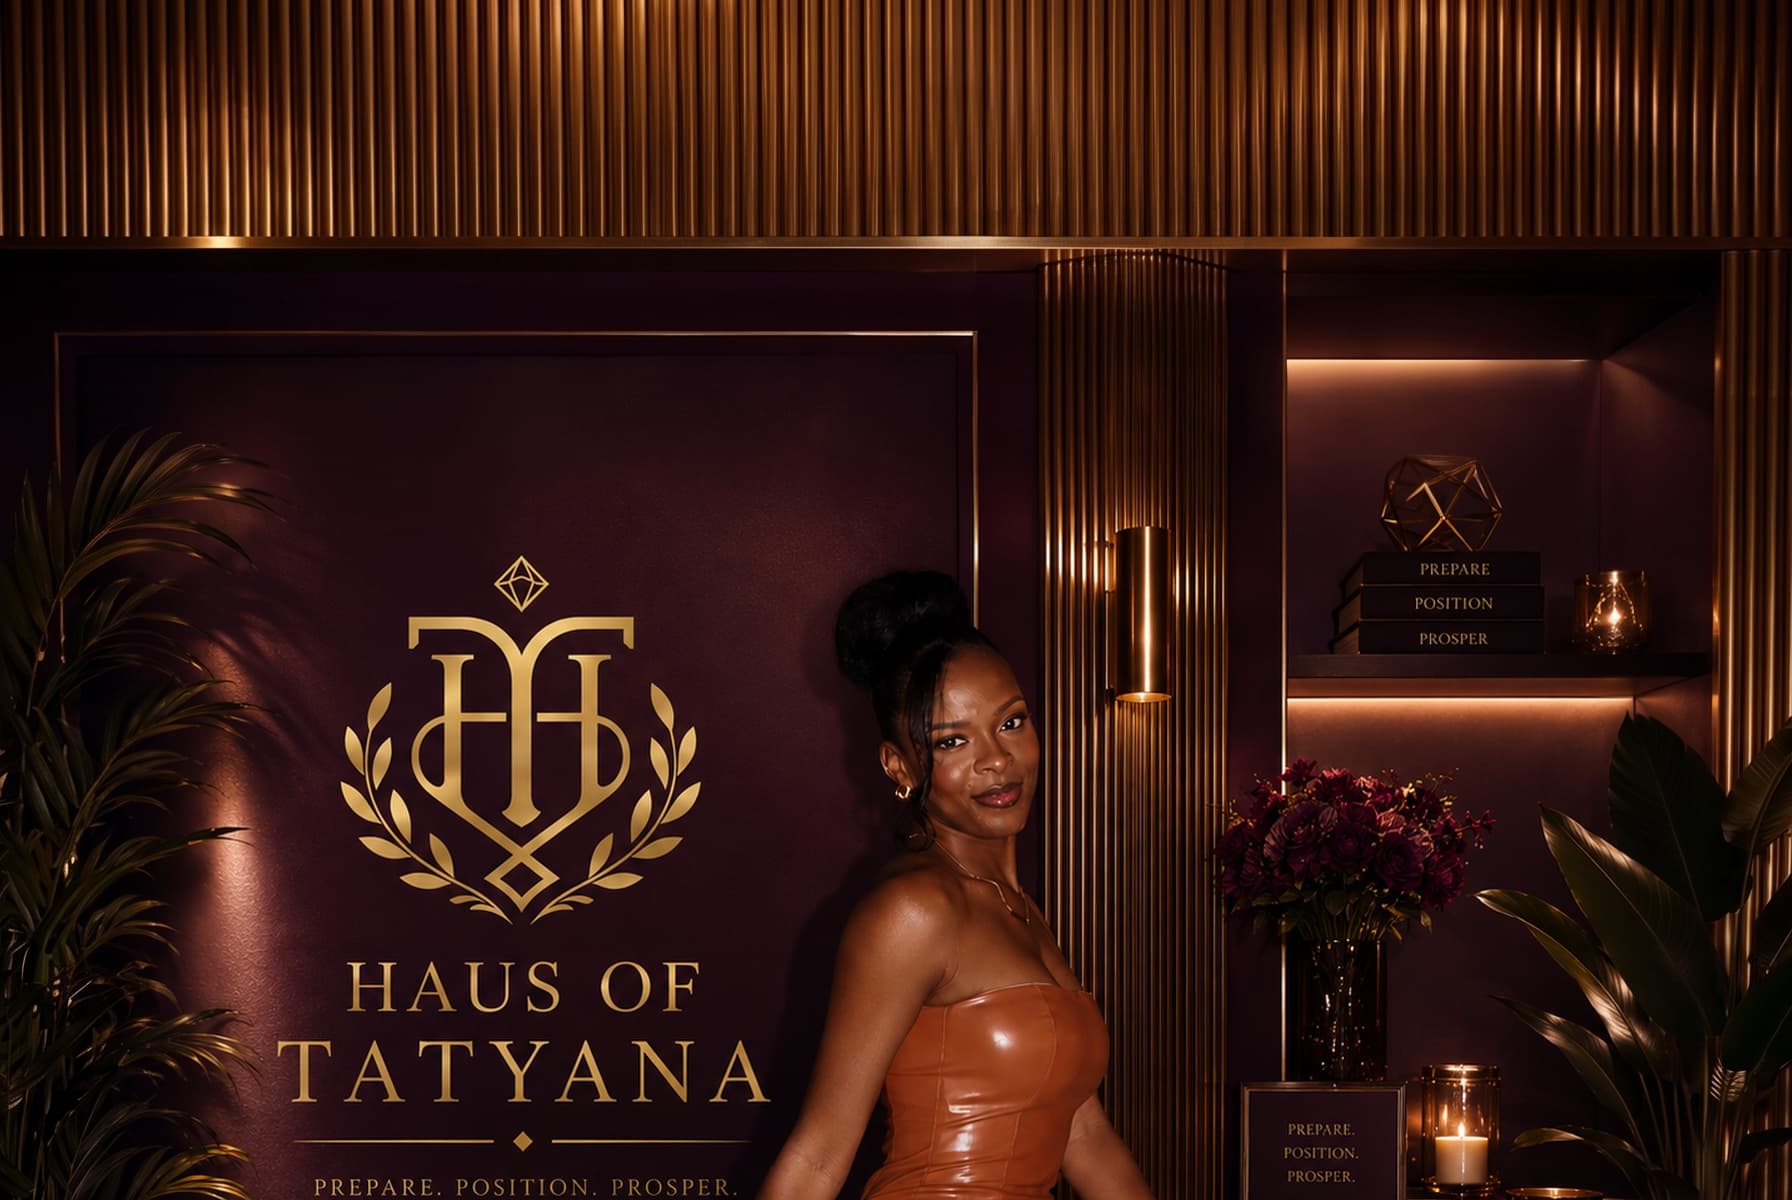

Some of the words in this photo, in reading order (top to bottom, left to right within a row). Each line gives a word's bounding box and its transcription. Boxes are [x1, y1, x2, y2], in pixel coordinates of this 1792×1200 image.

[1420, 562, 1490, 575] PREPARE
[1415, 597, 1493, 610] POSITION
[1419, 632, 1488, 645] PROSPER
[346, 961, 560, 1012] HAUS
[600, 961, 699, 1012] OF
[277, 1040, 771, 1103] TATYANA
[1288, 1123, 1355, 1135] PREPARE.
[1284, 1147, 1359, 1159] POSITION.
[1287, 1170, 1355, 1182] PROSPER.
[314, 1178, 443, 1197] PREPARE.
[456, 1178, 598, 1197] POSITION.
[611, 1178, 738, 1197] PROSPER.
